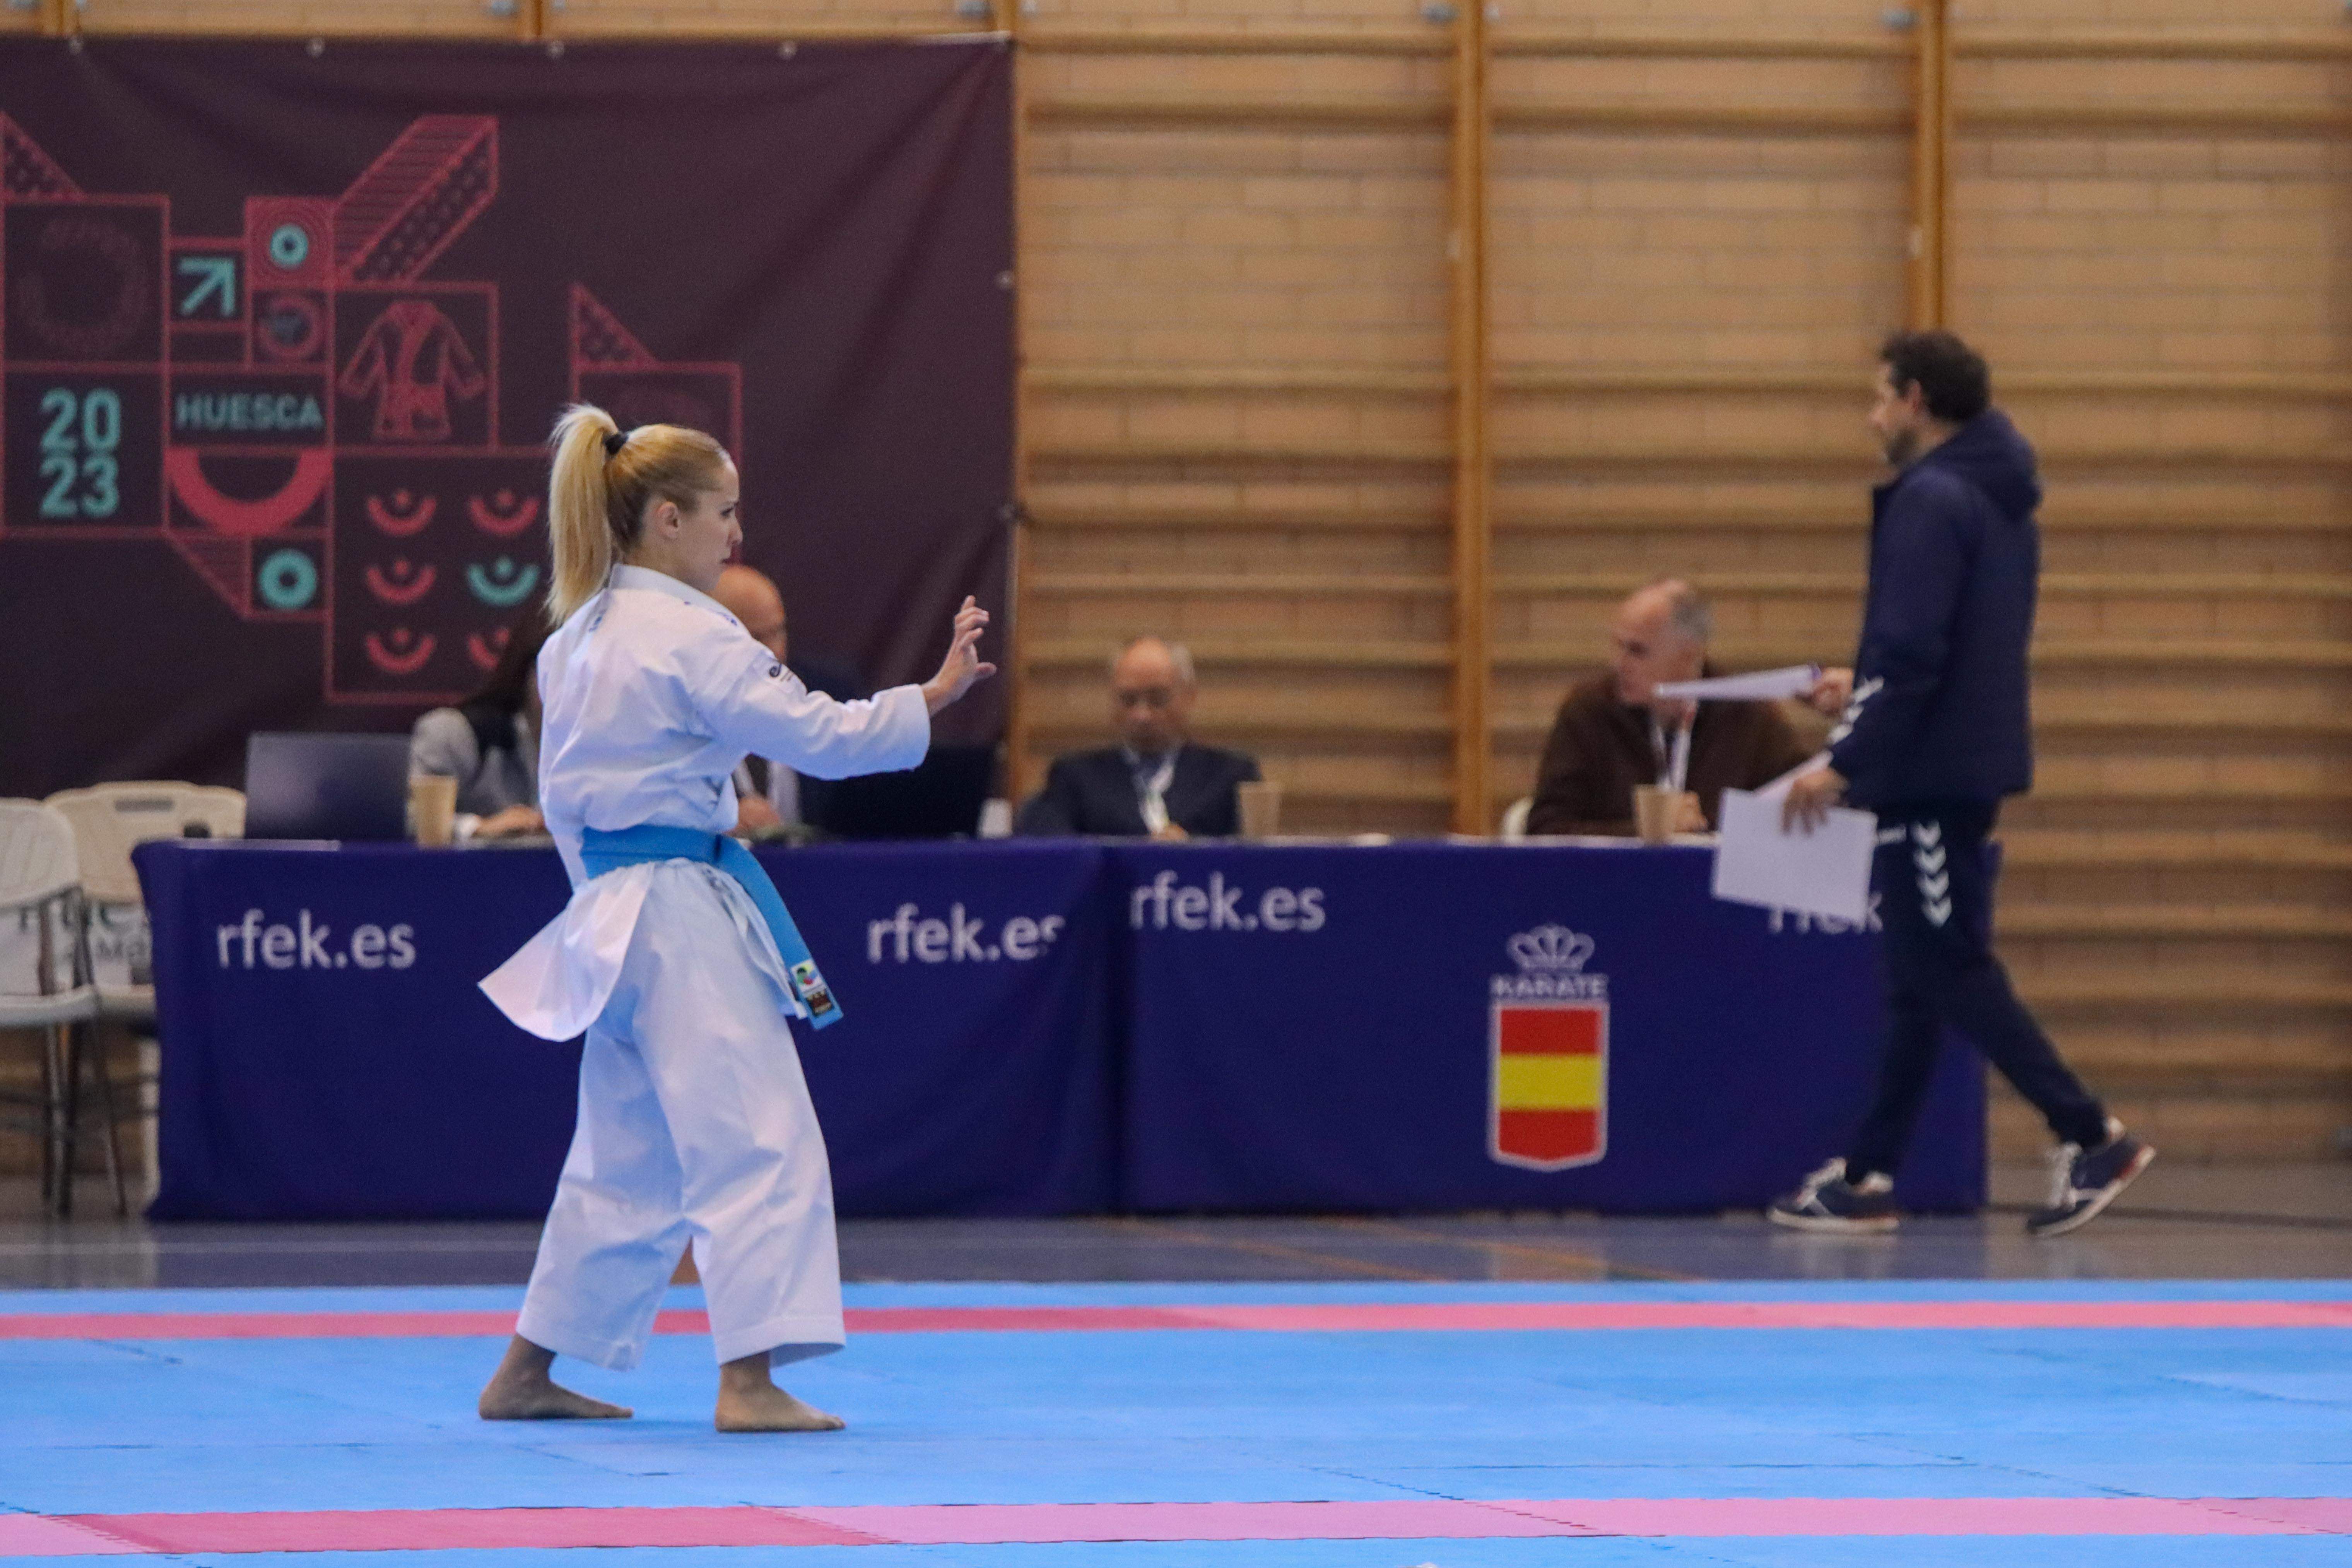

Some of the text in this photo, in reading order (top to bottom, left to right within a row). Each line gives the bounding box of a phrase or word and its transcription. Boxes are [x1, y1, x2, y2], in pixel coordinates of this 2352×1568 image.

[41, 388, 120, 450] 20
[174, 393, 325, 428] HUESCA
[41, 457, 118, 516] 23
[1130, 870, 1326, 930] rfek.es
[217, 908, 416, 968] rfek.es
[1491, 974, 1607, 996] KARATE
